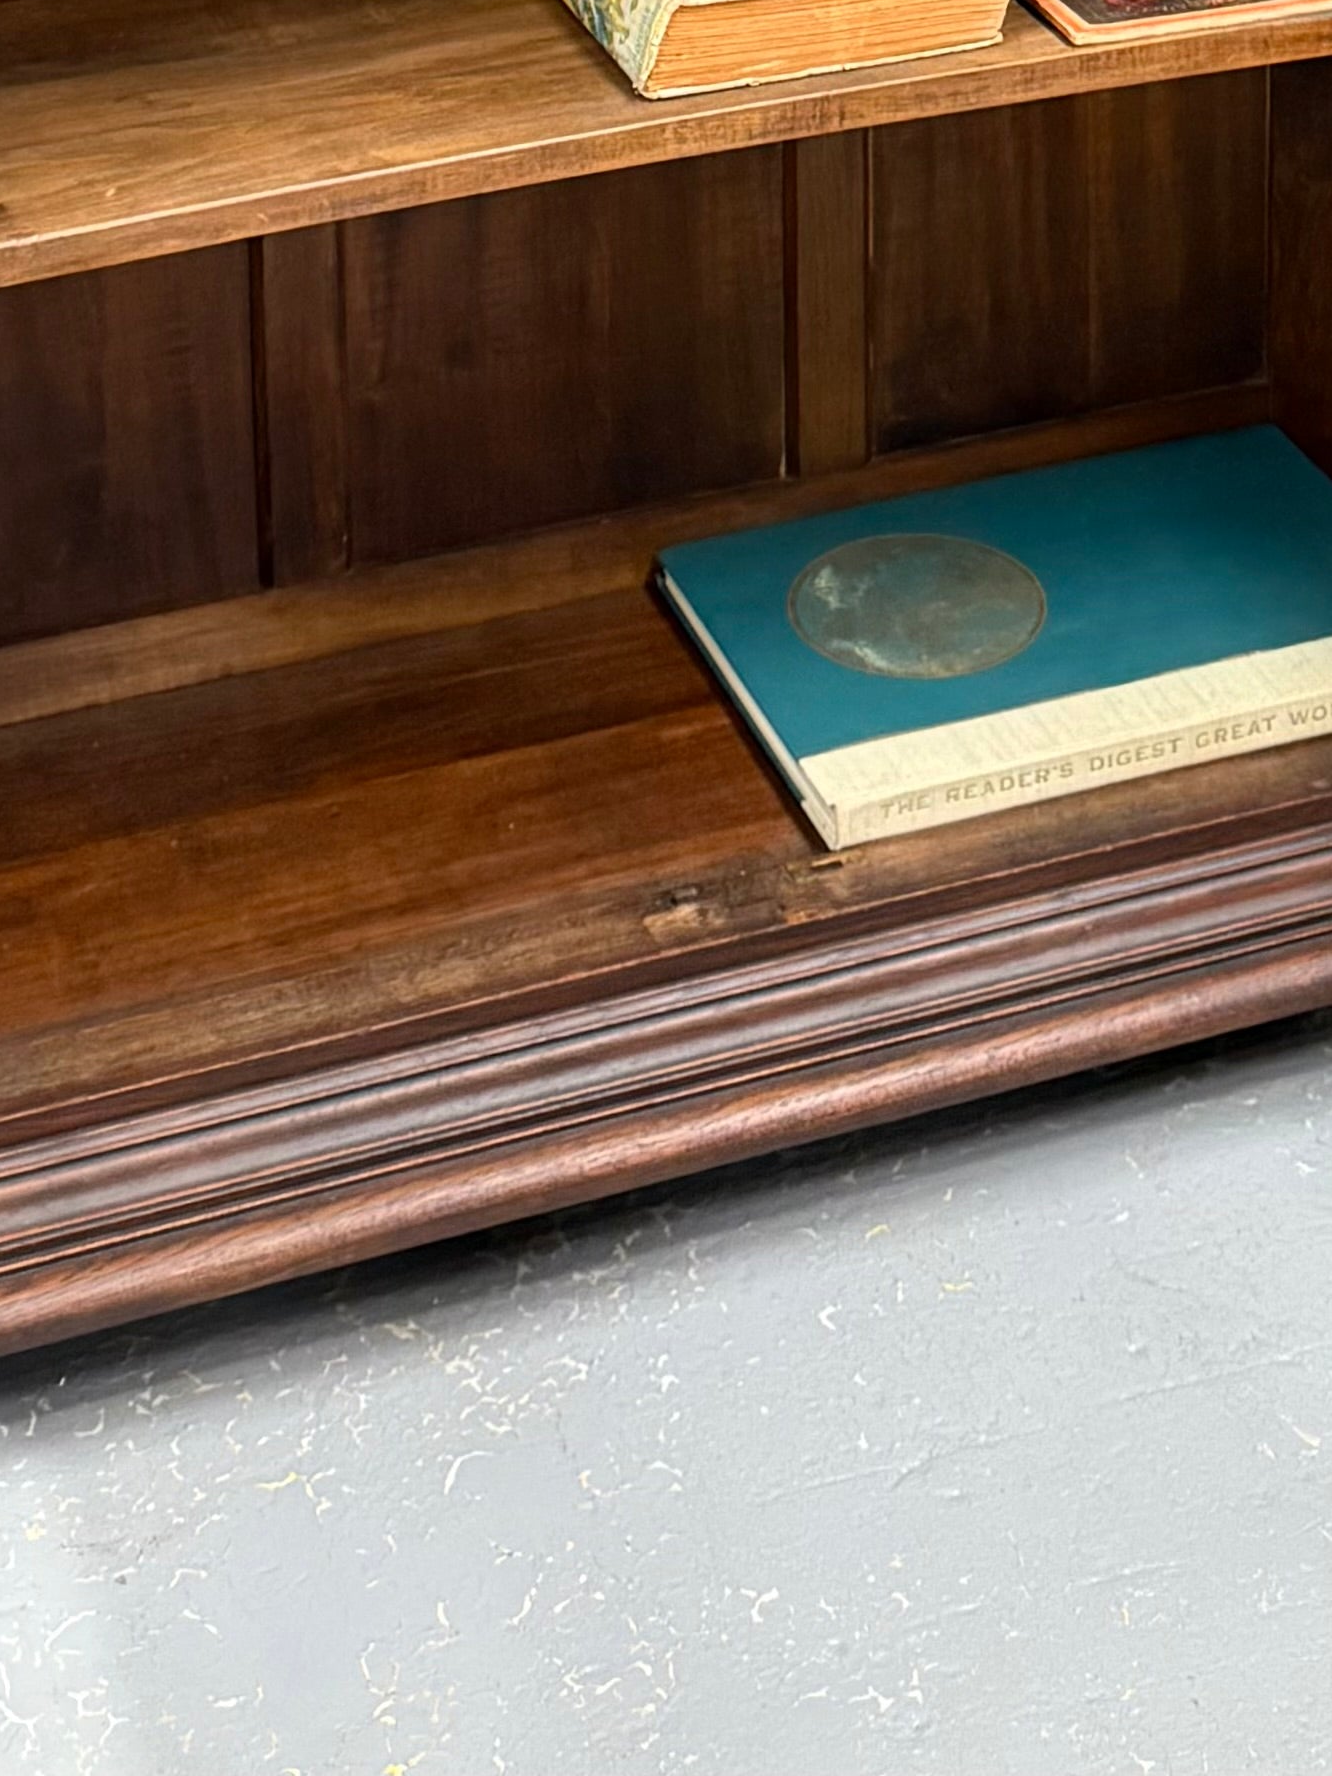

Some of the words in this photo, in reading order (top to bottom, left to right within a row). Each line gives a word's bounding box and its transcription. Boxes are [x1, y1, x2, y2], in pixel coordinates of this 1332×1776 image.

[879, 794, 937, 820] THE
[945, 762, 1074, 804] READER'S
[1088, 737, 1183, 773] DIGEST
[1195, 715, 1276, 749] GREAT
